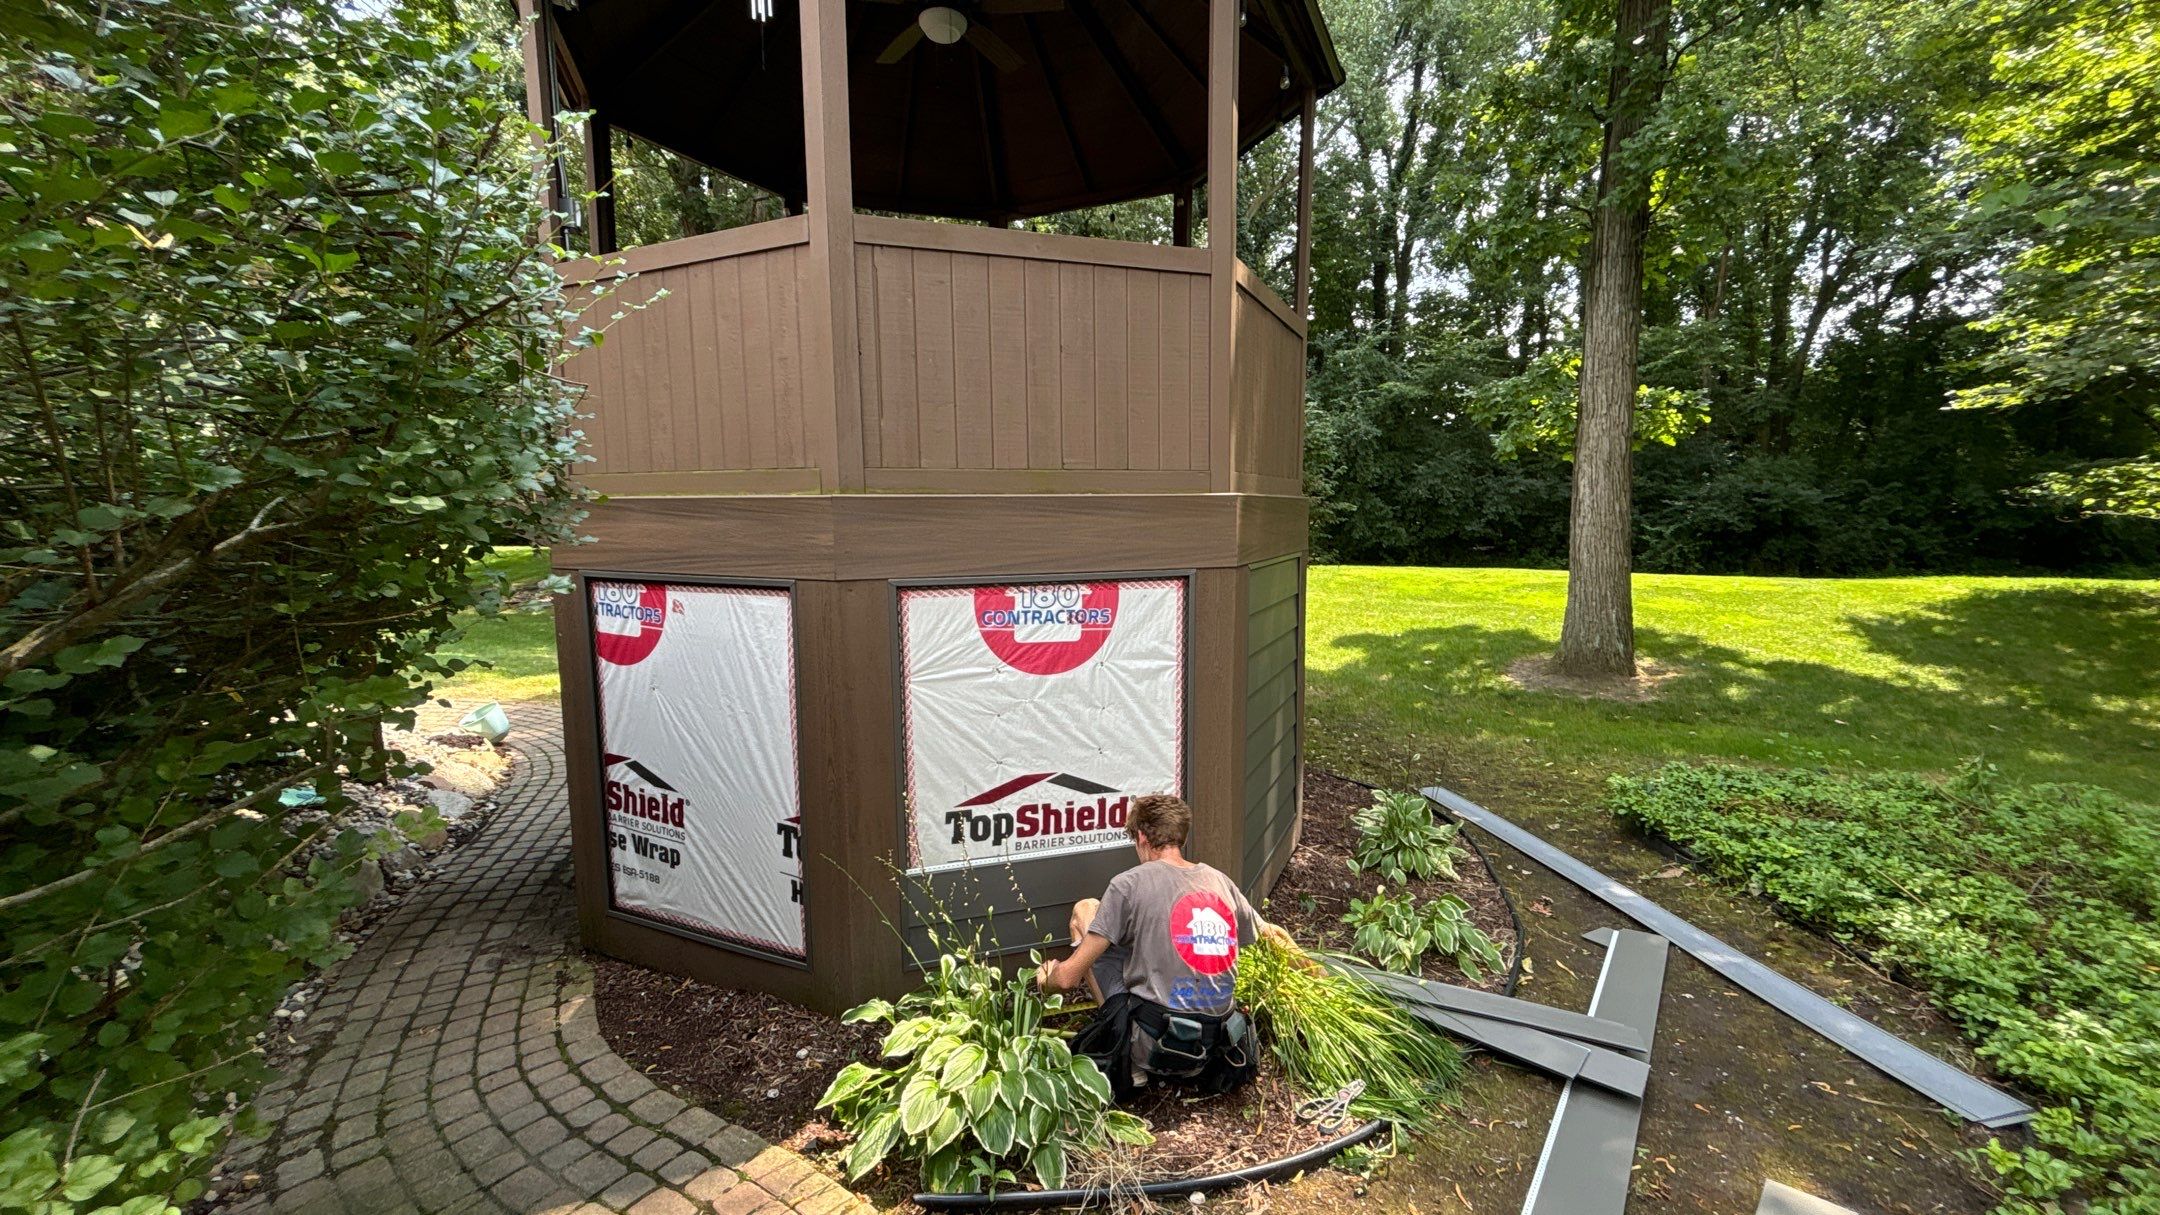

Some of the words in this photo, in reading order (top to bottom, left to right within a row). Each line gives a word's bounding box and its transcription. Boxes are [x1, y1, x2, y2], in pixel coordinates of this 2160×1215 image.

[1020, 584, 1081, 609] 180
[982, 609, 1111, 625] CONTRACTORS
[642, 821, 686, 841] SOLUTIONS
[945, 796, 1130, 846] TopShield
[631, 833, 681, 869] Wrap
[1015, 837, 1065, 851] BARRIER
[1069, 831, 1128, 845] SOLUTIONS
[1193, 920, 1227, 937] 180
